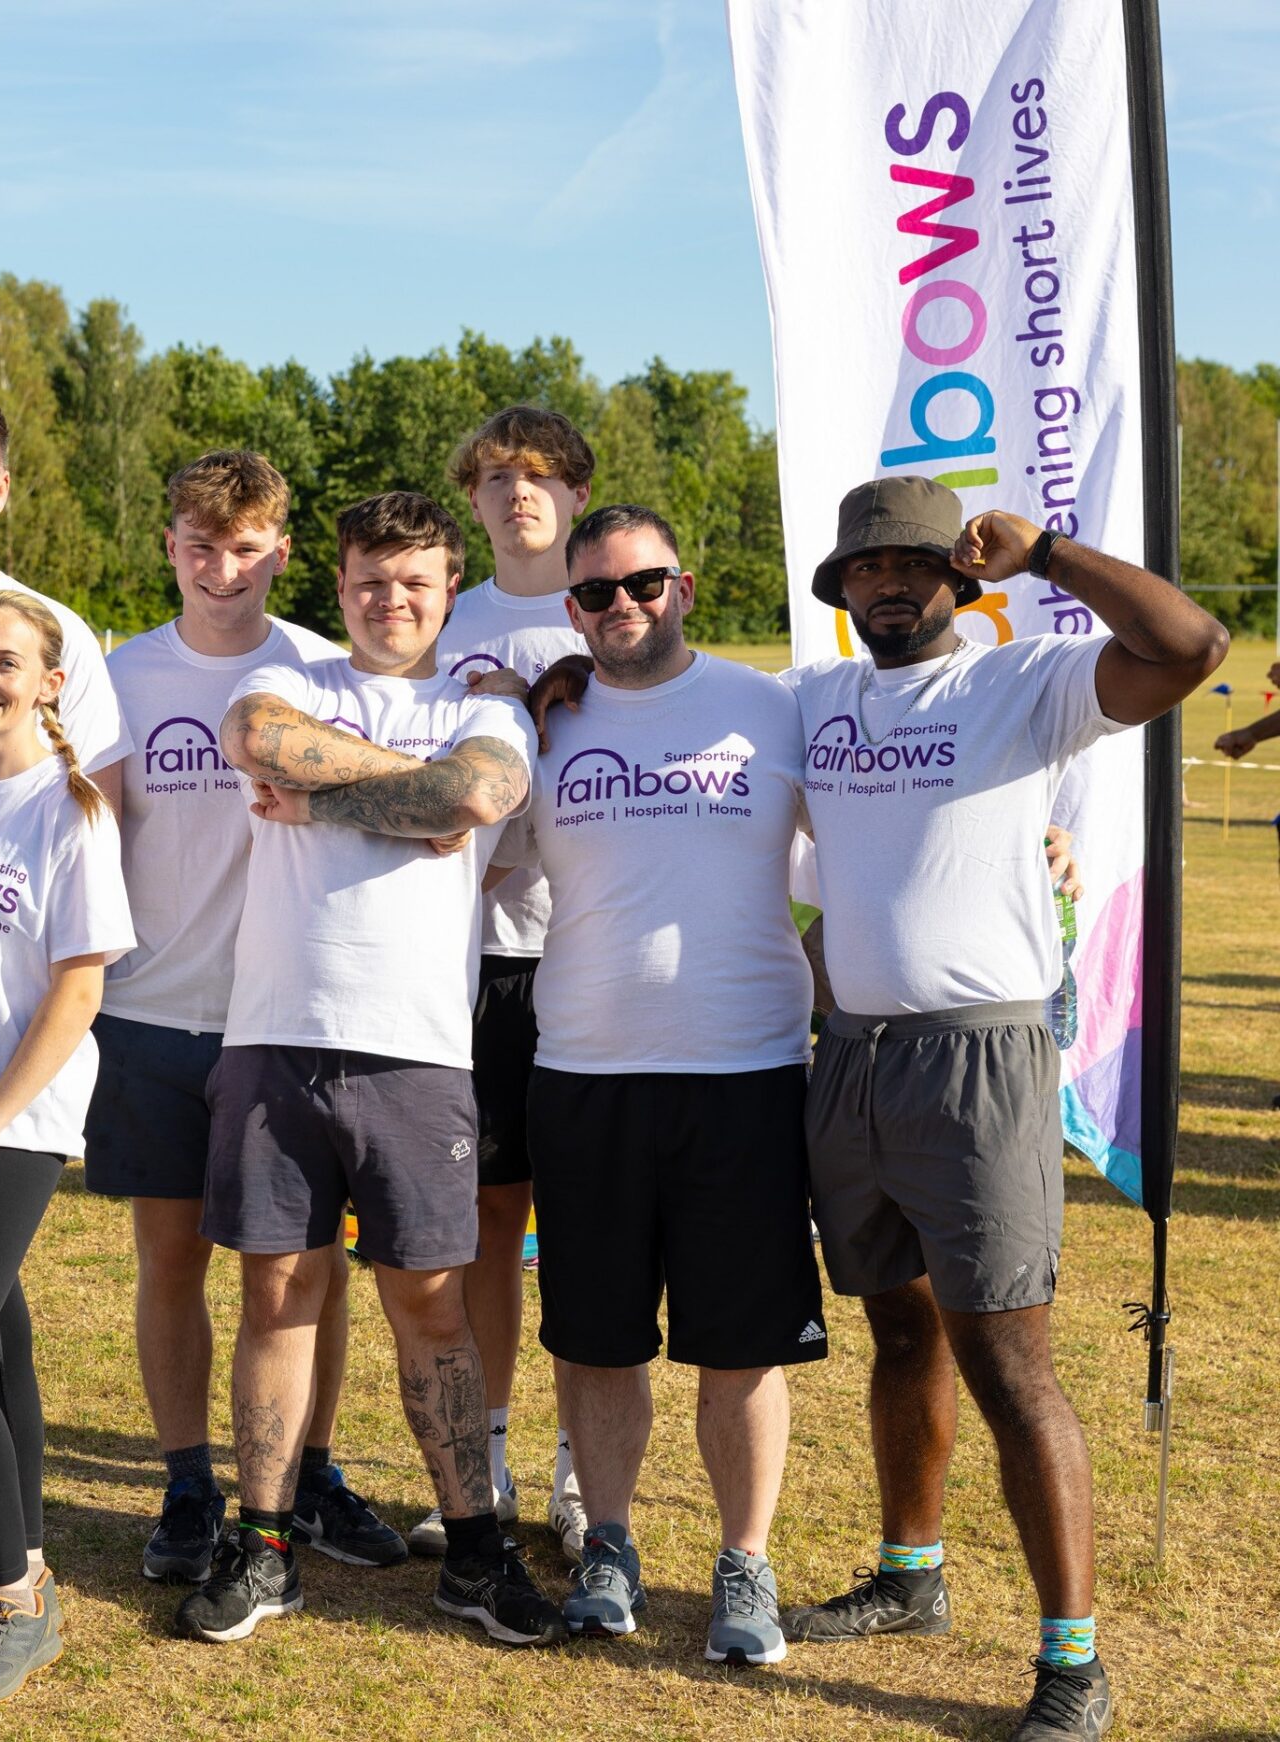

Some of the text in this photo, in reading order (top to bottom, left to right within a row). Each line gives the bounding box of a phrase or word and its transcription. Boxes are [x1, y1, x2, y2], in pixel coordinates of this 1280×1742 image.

[1003, 78, 1052, 205] lives
[1012, 218, 1065, 367] short
[145, 738, 235, 775] rain
[664, 751, 749, 766] Supporting
[806, 736, 956, 774] rainbows
[146, 780, 198, 794] Hospice
[556, 764, 750, 808] rainbows
[847, 780, 897, 797] Hospital
[912, 777, 955, 790] Home
[555, 803, 752, 828] Hospice Hospital Home
[798, 1331, 826, 1343] adidas
